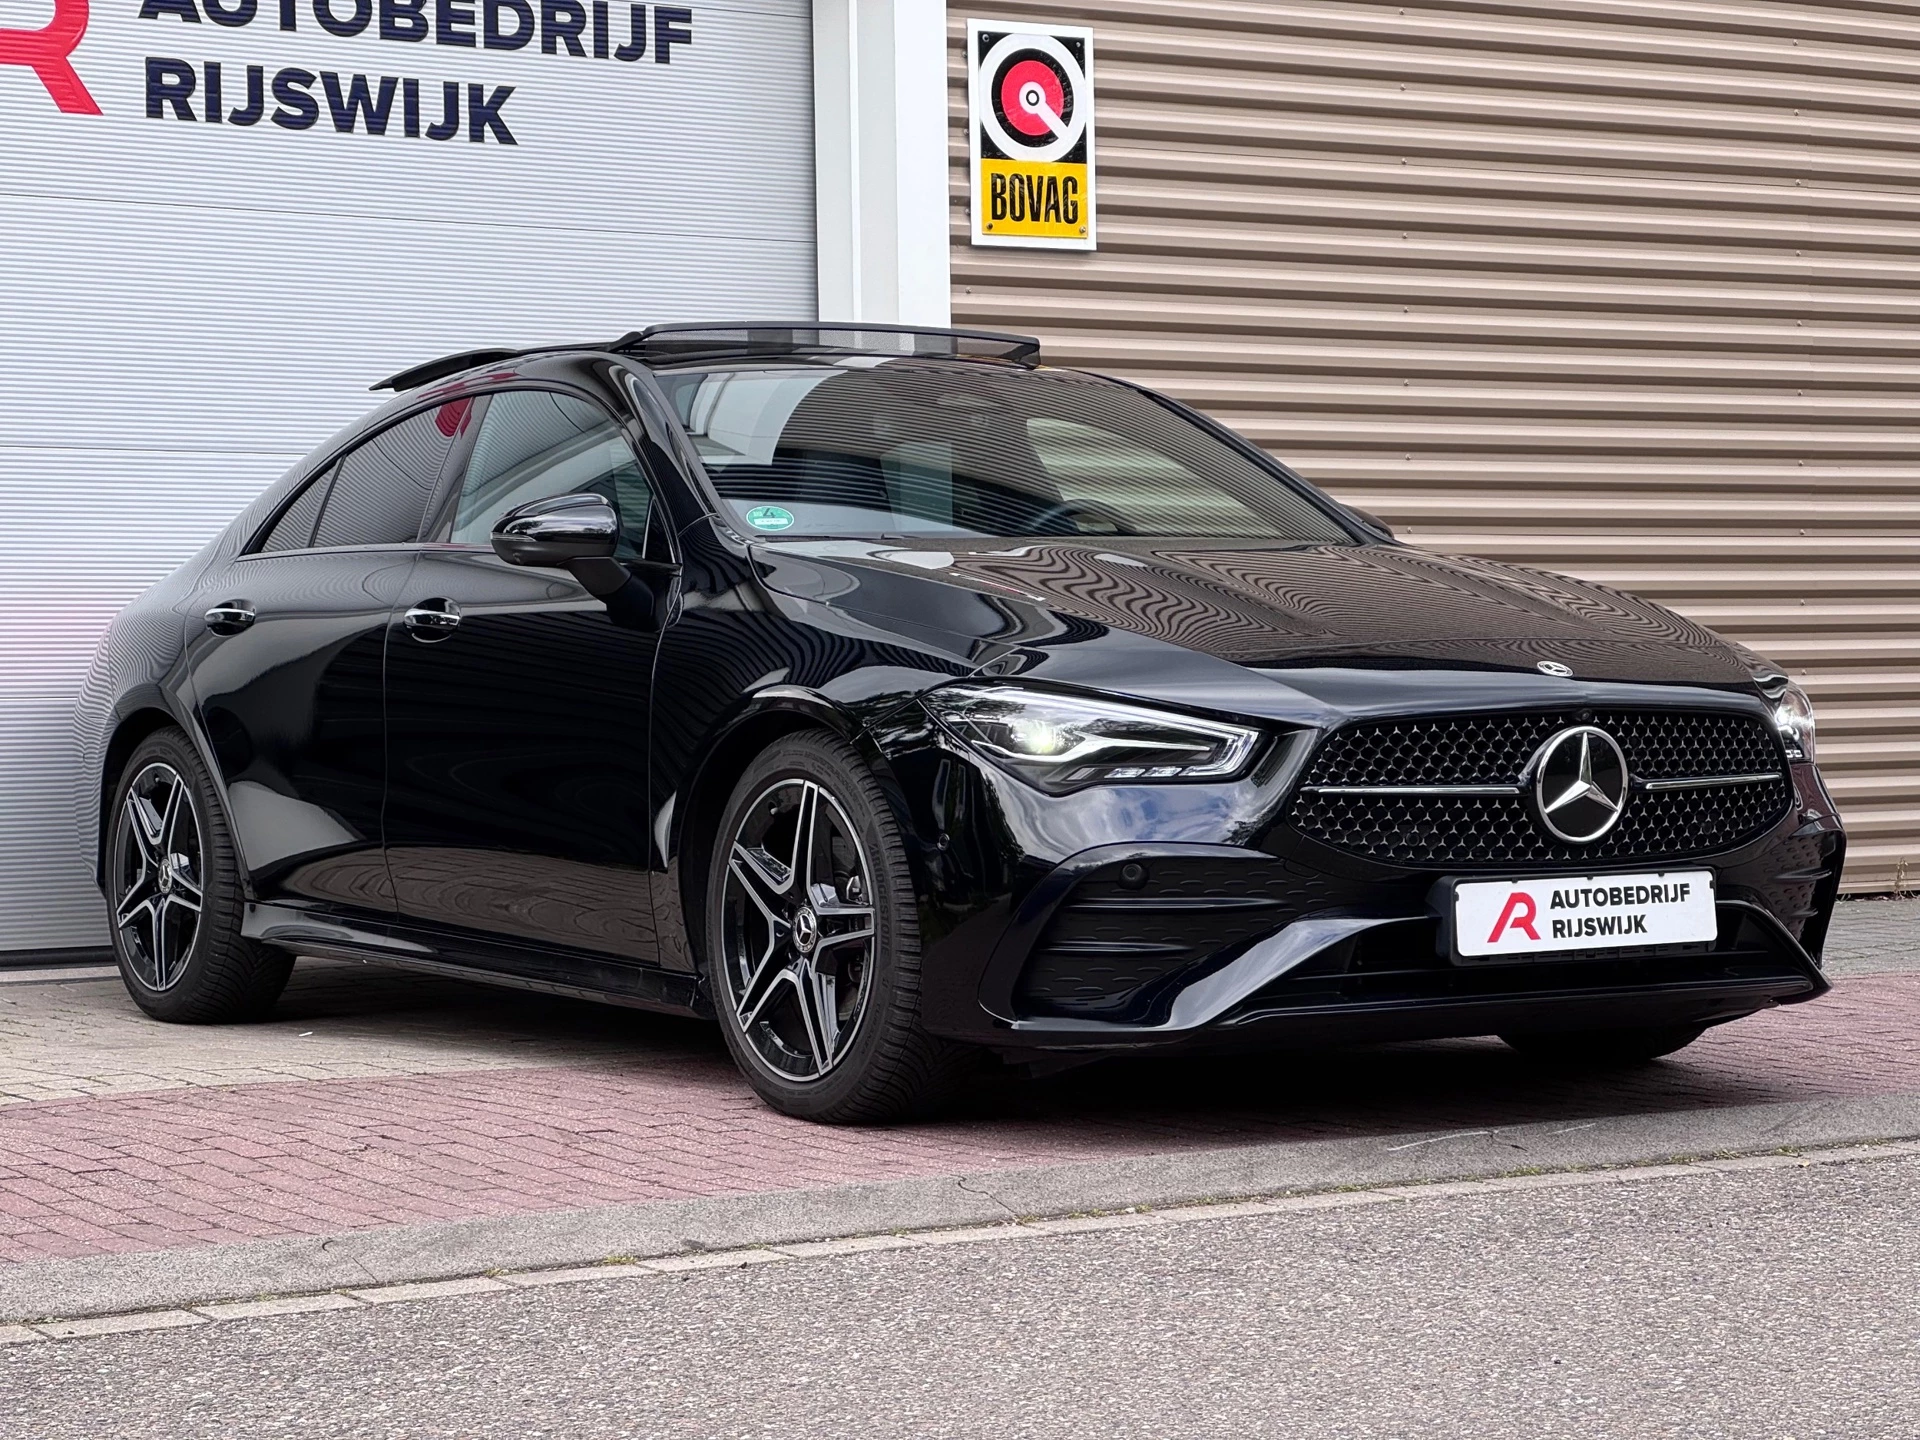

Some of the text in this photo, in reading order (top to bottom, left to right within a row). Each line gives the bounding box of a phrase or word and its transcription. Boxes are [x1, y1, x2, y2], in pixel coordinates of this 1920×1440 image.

[145, 56, 518, 145] RIJSWIJK
[991, 172, 1078, 225] BOVAG
[869, 843, 890, 957] BRIDGESTONE
[1550, 883, 1691, 910] AUTOBEDRIJF
[1552, 914, 1648, 939] RIJSWIJK
